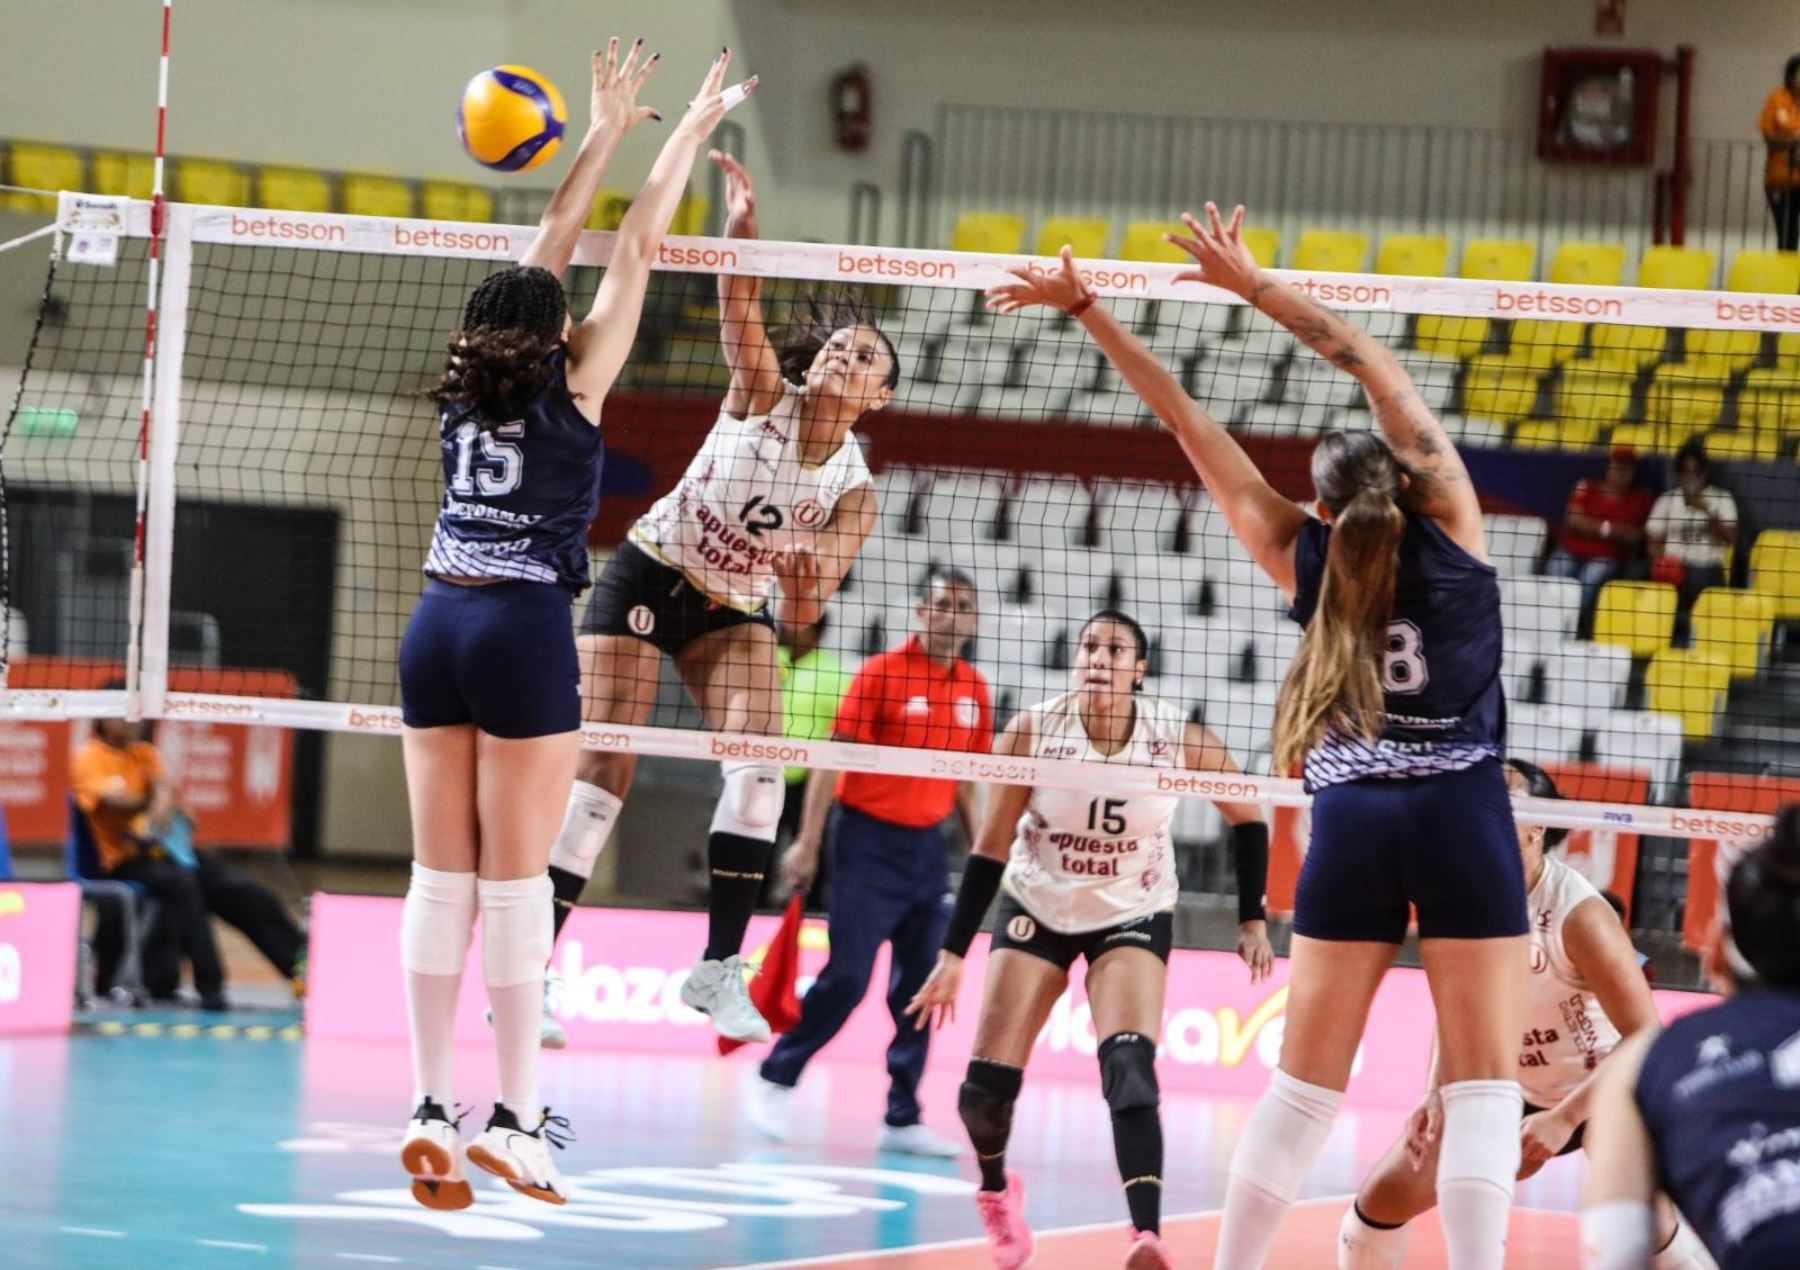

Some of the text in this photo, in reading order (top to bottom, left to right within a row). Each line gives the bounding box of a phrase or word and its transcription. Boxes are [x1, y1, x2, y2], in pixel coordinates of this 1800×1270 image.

[230, 213, 346, 243] betsson
[394, 223, 511, 252] betsson
[658, 241, 737, 268] tsson
[837, 252, 956, 280] betsson
[1494, 288, 1623, 317] betsson
[1716, 298, 1800, 325] betss
[449, 418, 526, 496] 15
[739, 495, 783, 537] 12
[697, 536, 754, 576] total
[348, 708, 402, 729] bets
[579, 729, 631, 747] sson
[711, 737, 808, 762] betsson
[1156, 773, 1259, 797] betsson
[1087, 797, 1129, 835] 15
[1062, 854, 1120, 877] total
